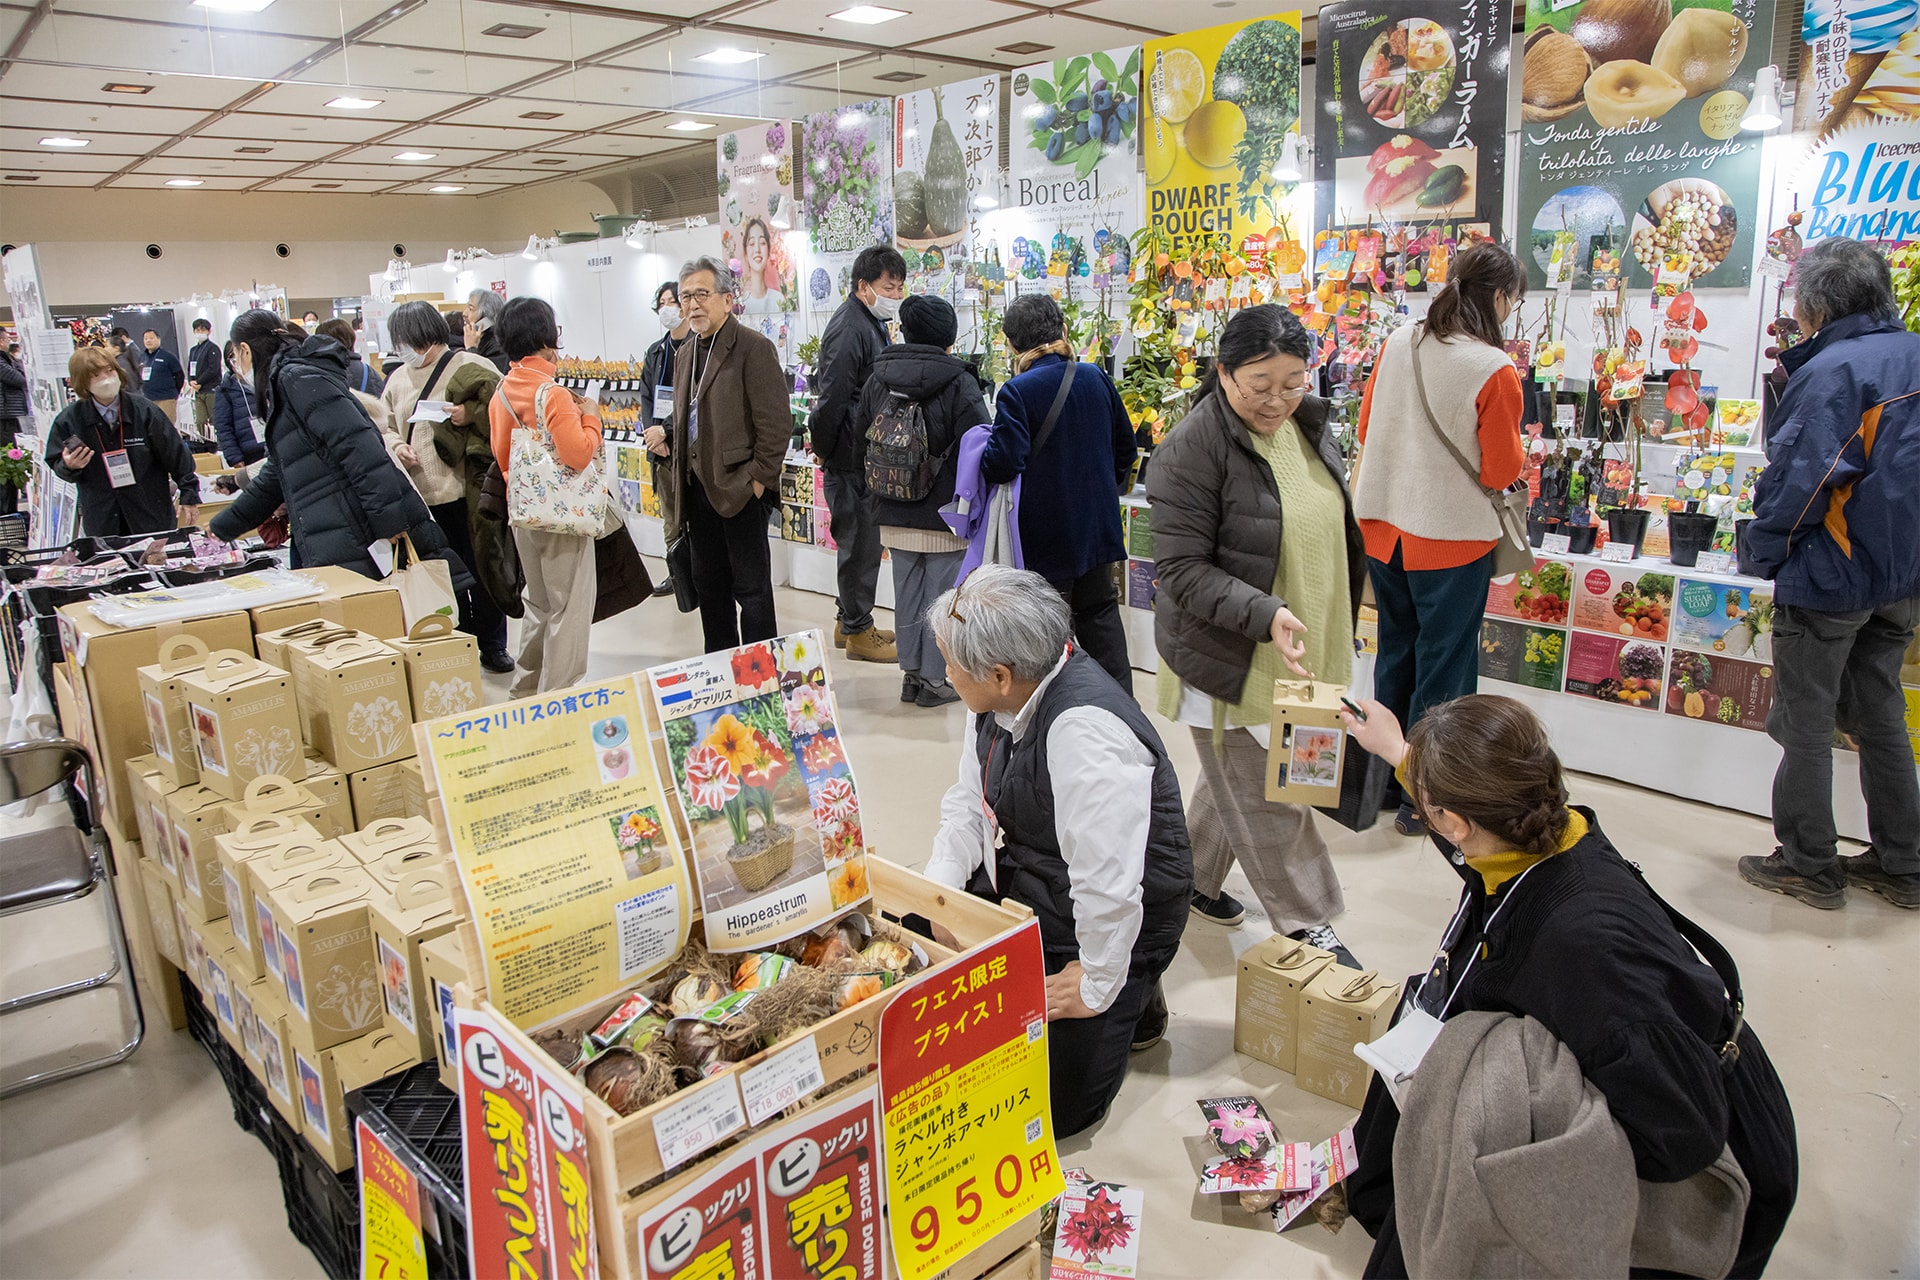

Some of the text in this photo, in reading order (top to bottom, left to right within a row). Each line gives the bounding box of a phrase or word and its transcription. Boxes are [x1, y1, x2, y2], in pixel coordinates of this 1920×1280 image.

[1329, 10, 1367, 23] Microcitrus
[1335, 16, 1375, 29] Australasica
[1816, 39, 1831, 119] 耐寒性バナナ
[1704, 102, 1744, 115] イタリアン
[1706, 112, 1741, 123] ヘーゼル
[1591, 115, 1662, 149] gentile
[1711, 121, 1735, 132] ナッツ
[1538, 136, 1747, 172] trilobata delle langhe
[1019, 169, 1099, 208] Boreal
[1539, 171, 1564, 183] トンダ
[1151, 183, 1231, 213] DWARF
[1683, 593, 1713, 603] SUGAR
[1688, 600, 1711, 609] LOAF
[421, 655, 471, 673] AMARYLLIS
[676, 668, 711, 684] オランダから
[343, 672, 397, 695] AMARYLLIS
[231, 694, 286, 718] AMARYLLIS
[727, 892, 808, 932] Hippeastrum
[728, 930, 741, 941] The
[785, 906, 809, 923] amaryllis
[911, 954, 1008, 1022] フェス限定
[914, 991, 1004, 1058] プライス！
[683, 1131, 703, 1149] 950
[894, 1100, 970, 1158] ラベル付き
[895, 1087, 1032, 1181] ジャンボアマリリス
[527, 1123, 548, 1247] PRICE DOWN
[904, 1152, 977, 1204] 本日限定現品持ち帰り
[857, 1162, 875, 1280] PRICE DOWN
[740, 1223, 757, 1280] PRICE
